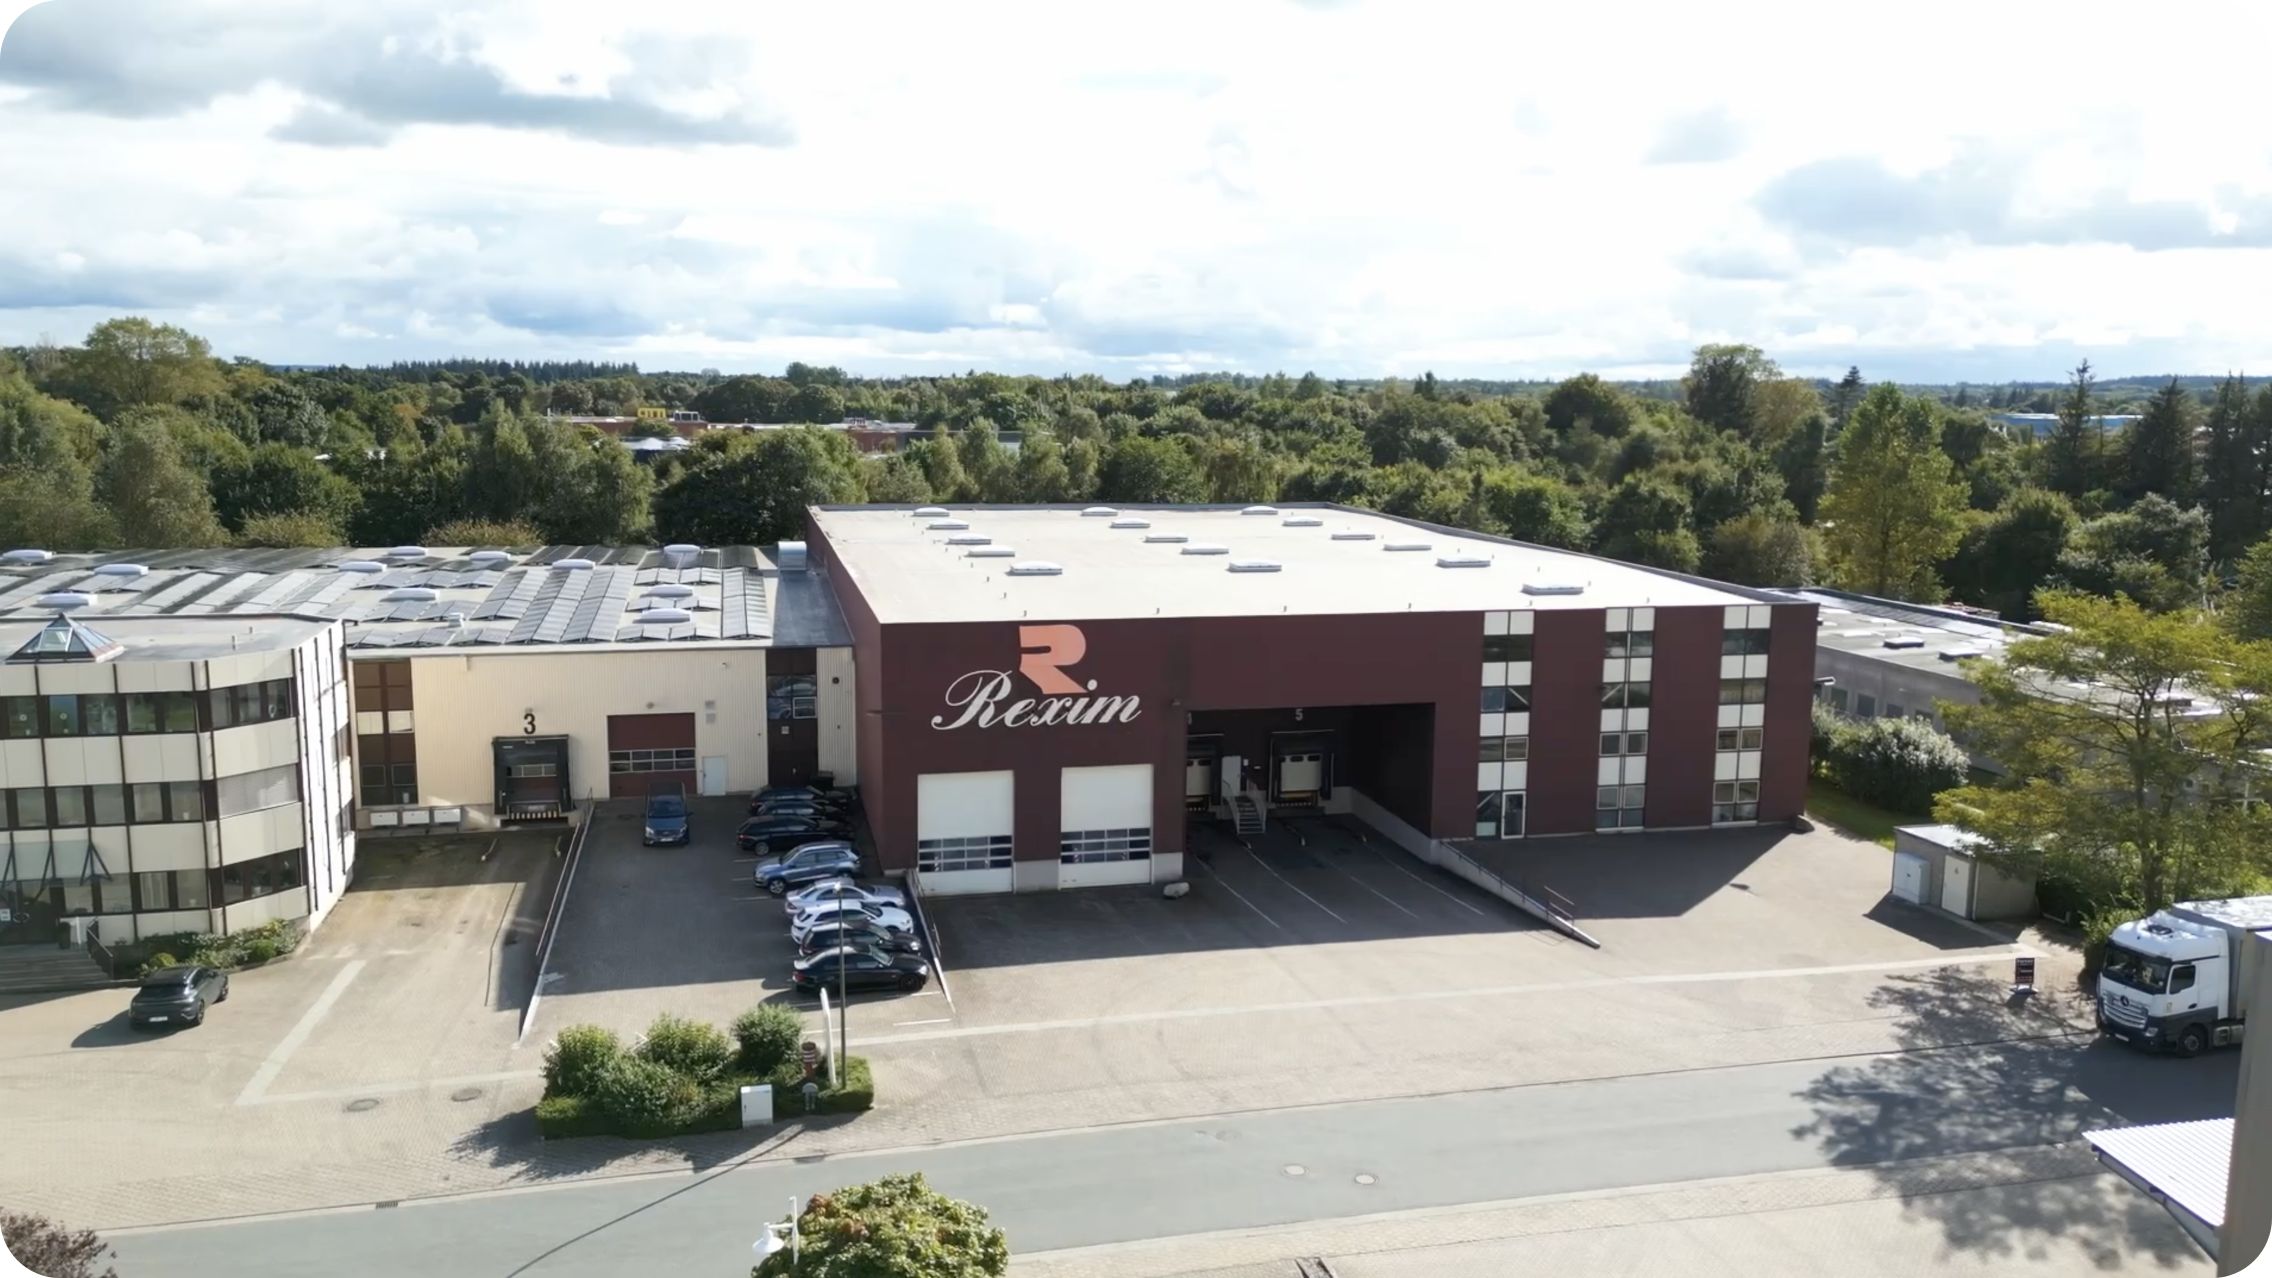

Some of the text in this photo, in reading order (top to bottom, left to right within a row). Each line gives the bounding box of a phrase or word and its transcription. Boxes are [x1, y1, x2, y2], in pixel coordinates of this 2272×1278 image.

[1019, 624, 1089, 694] R
[931, 669, 1142, 730] Rexim
[1295, 708, 1304, 722] 5
[523, 713, 536, 735] 3
